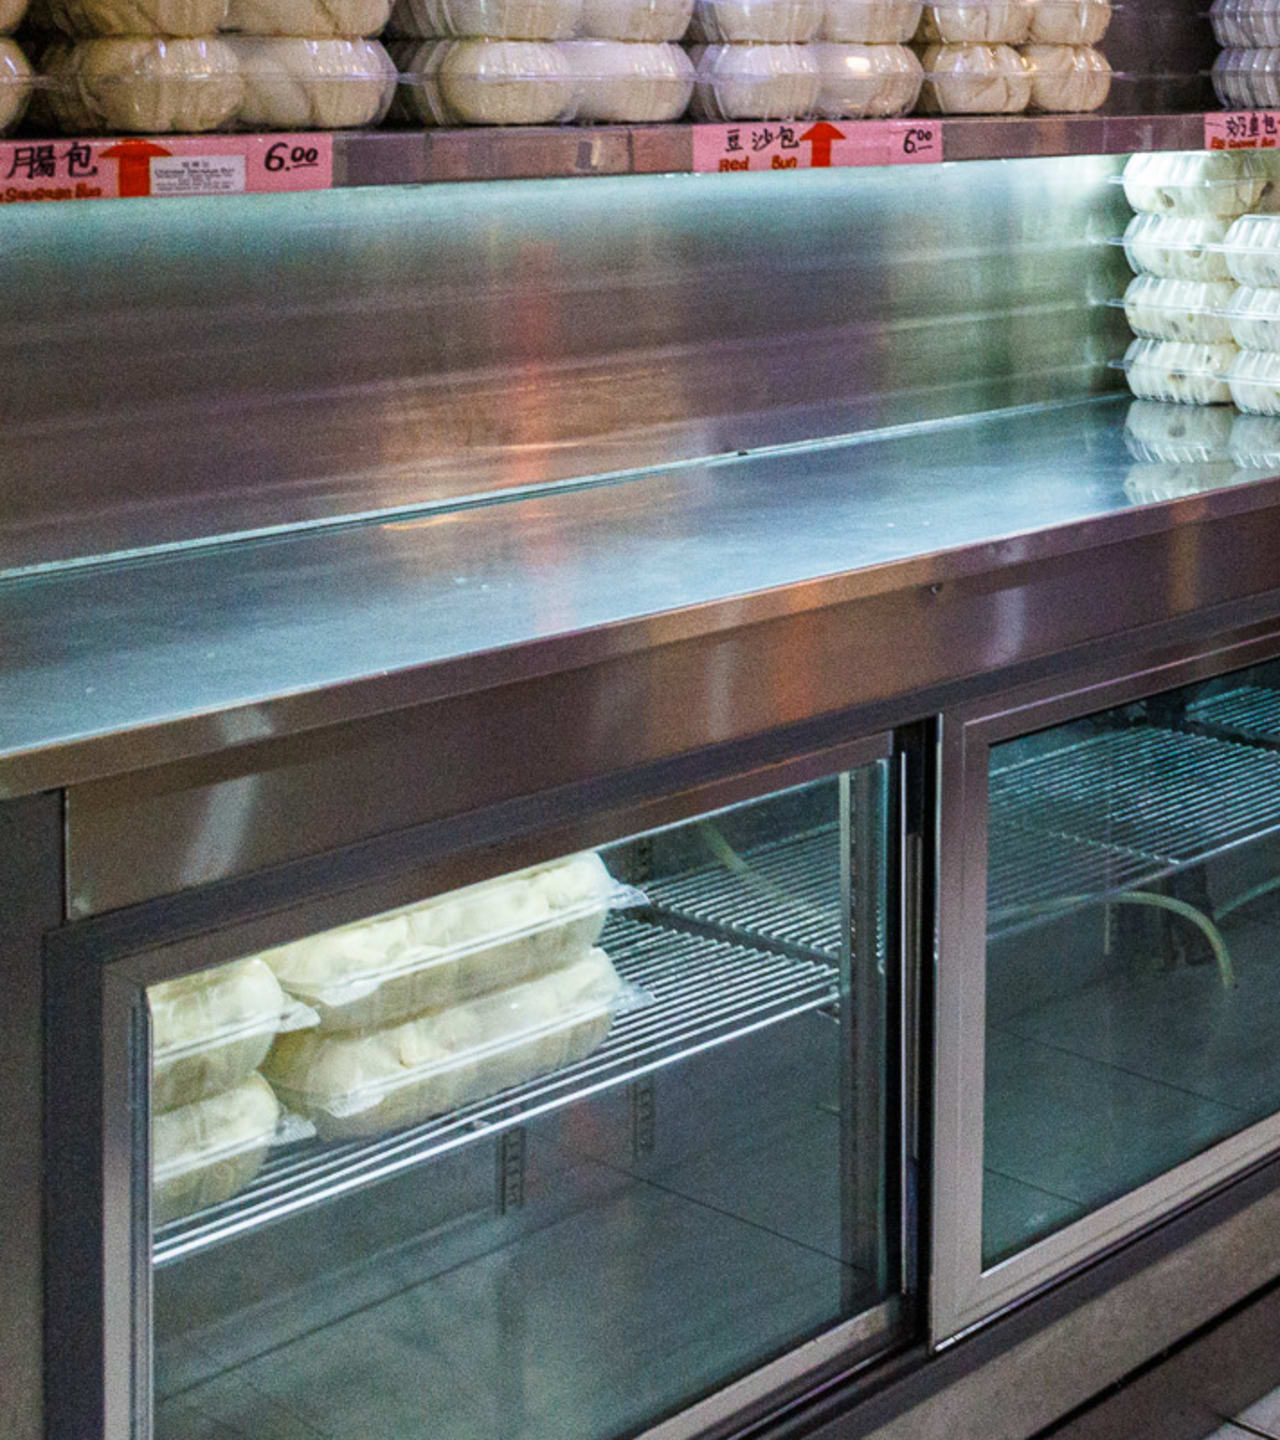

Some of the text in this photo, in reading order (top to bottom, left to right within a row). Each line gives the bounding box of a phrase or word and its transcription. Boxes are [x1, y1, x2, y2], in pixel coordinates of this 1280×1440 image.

[724, 126, 800, 152] 豆沙包
[263, 142, 319, 172] 6.00
[718, 155, 798, 173] Red Bun
